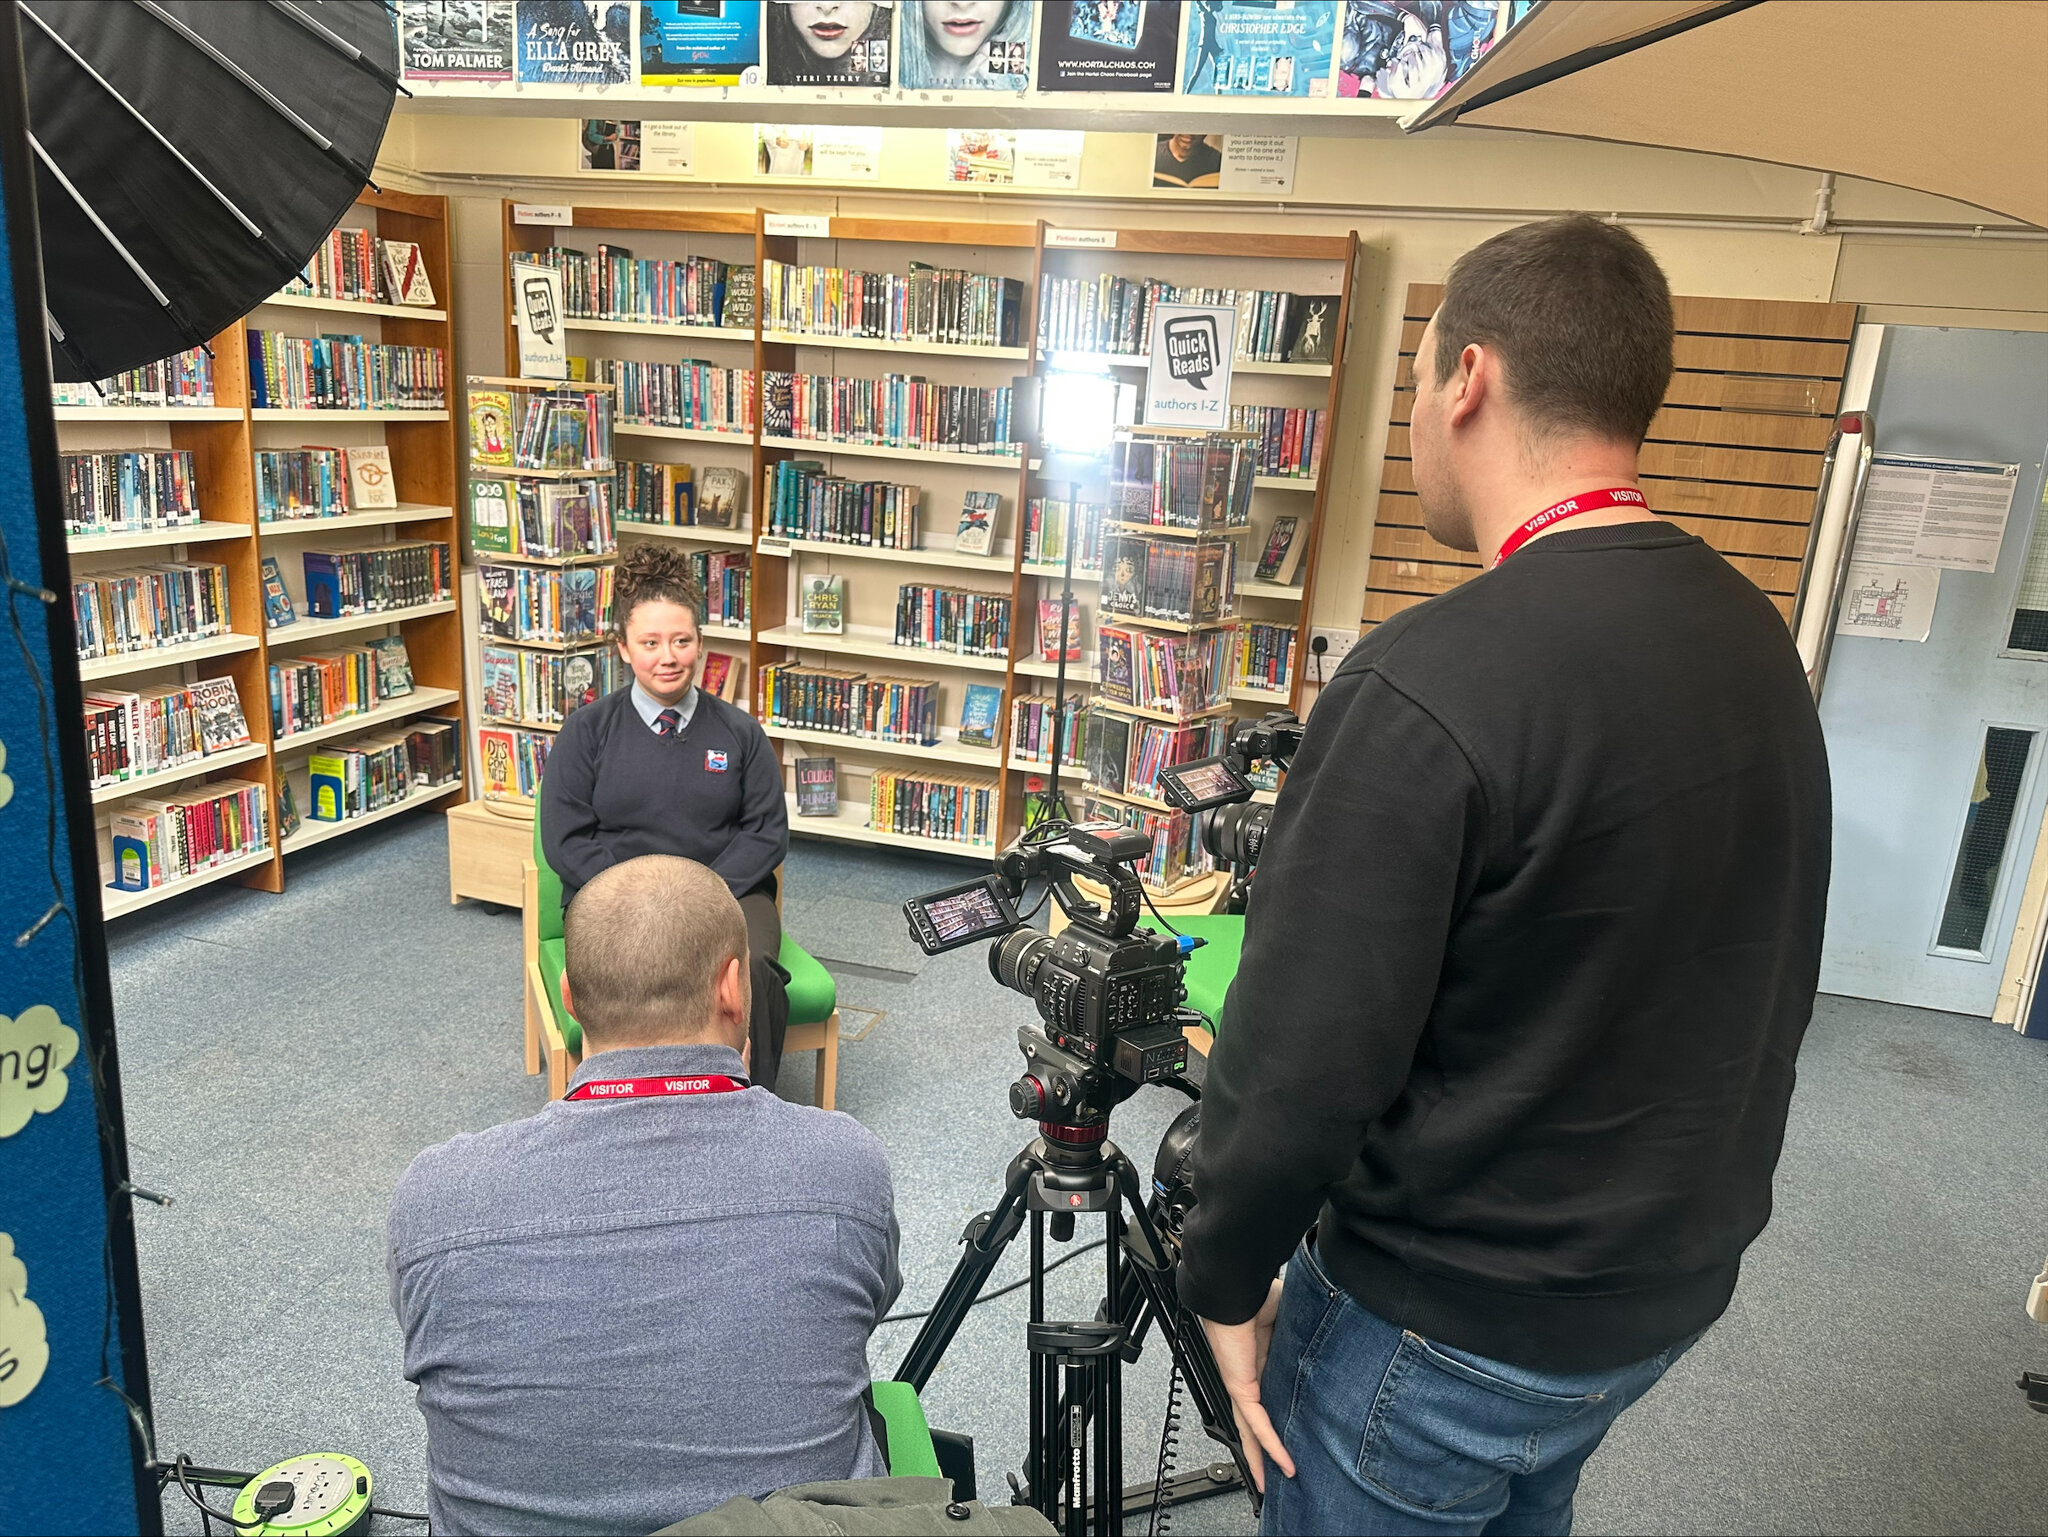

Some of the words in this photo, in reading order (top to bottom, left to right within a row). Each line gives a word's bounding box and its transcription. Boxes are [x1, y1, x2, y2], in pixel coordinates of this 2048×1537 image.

[526, 26, 538, 41] A
[539, 23, 566, 42] Song
[566, 23, 581, 45] for
[1220, 23, 1279, 34] CHRISTOPHER
[1280, 23, 1307, 34] EDGE
[525, 42, 569, 61] ELLA
[572, 42, 622, 61] GREY
[413, 53, 444, 68] TOM
[448, 54, 503, 69] PALMER
[542, 62, 568, 73] David
[569, 63, 603, 73] Almond
[929, 77, 955, 86] TERI
[962, 78, 996, 86] TERRY
[731, 288, 755, 296] WORLD
[732, 303, 751, 312] WILD
[1169, 332, 1207, 357] Quick
[1172, 356, 1210, 376] Reads
[1154, 399, 1197, 411] authors
[1201, 400, 1218, 412] I-Z
[711, 476, 728, 485] PAX
[1609, 490, 1644, 504] VISITOR
[1525, 500, 1579, 532] VISITOR
[486, 578, 508, 588] TRASH
[807, 593, 838, 601] CHRIS
[1108, 592, 1137, 603] JENNY'S
[809, 601, 837, 609] RYAN
[194, 683, 233, 701] ROBIN
[199, 694, 237, 711] HOOD
[488, 739, 508, 759] DIS
[801, 769, 834, 784] LOUDER
[801, 792, 836, 805] HUNGER
[589, 1083, 634, 1095] VISITOR
[665, 1080, 710, 1091] VISITOR
[1072, 1447, 1081, 1509] Manfrotto
